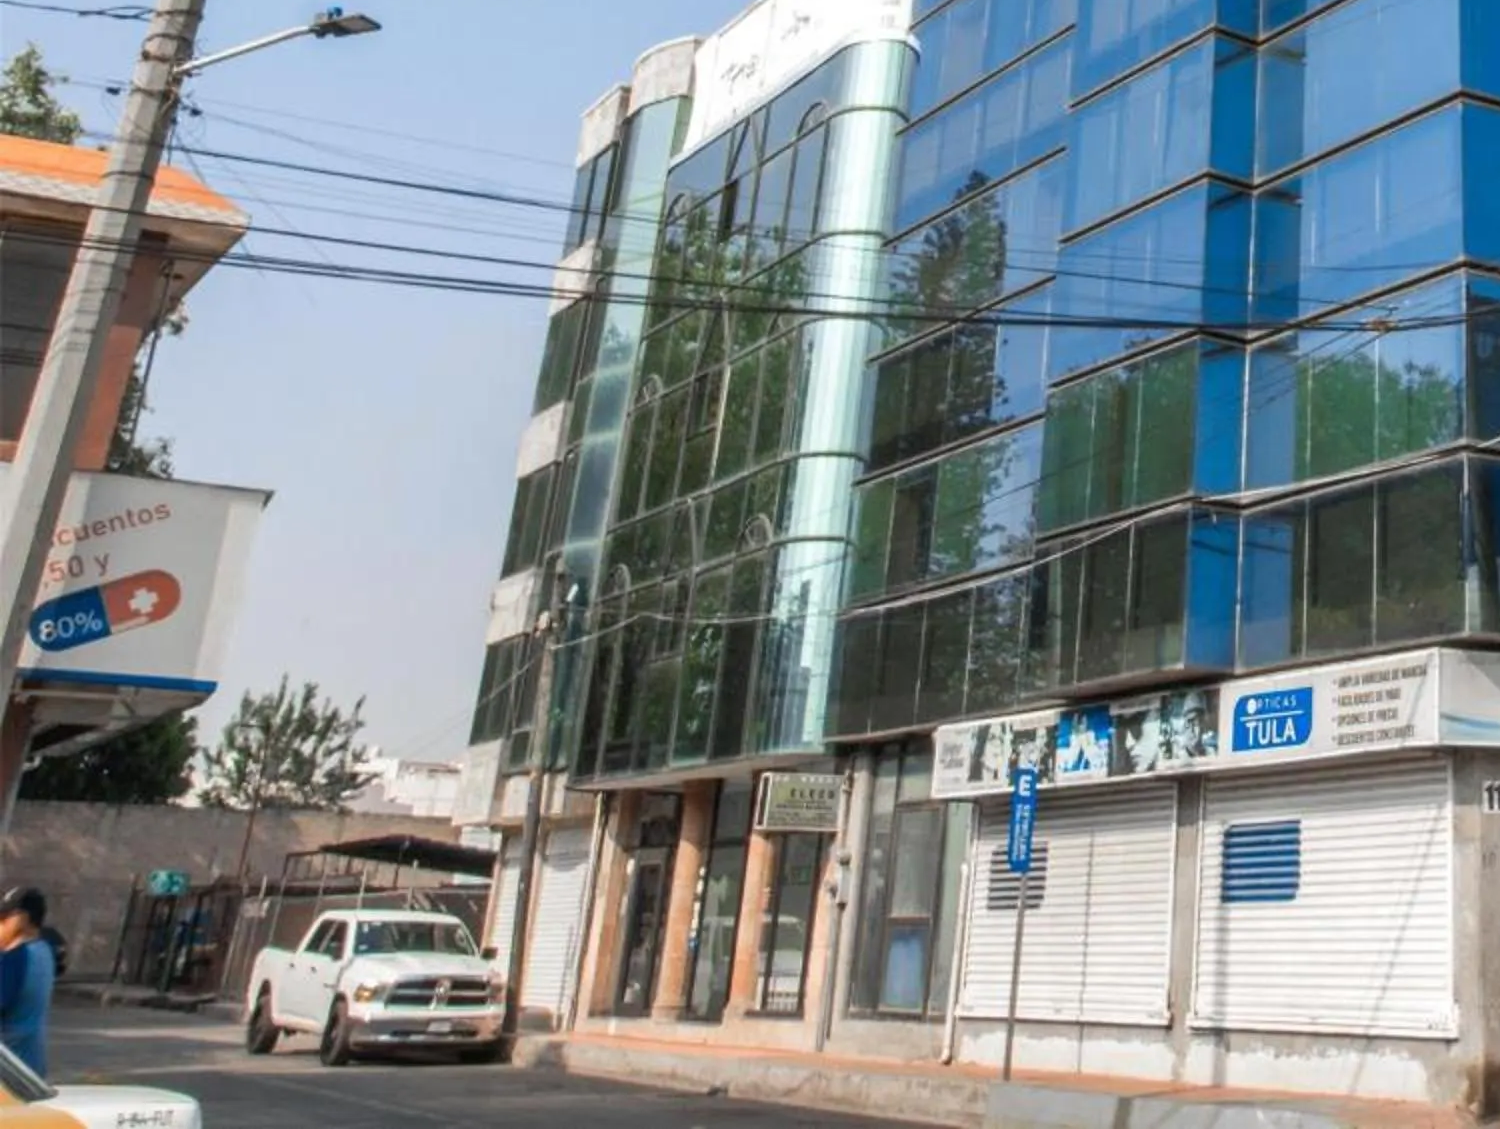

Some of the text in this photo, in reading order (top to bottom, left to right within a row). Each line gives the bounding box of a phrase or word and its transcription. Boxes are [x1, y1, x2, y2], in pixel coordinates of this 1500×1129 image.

[50, 502, 172, 547] cuentos
[94, 552, 110, 577] y
[38, 609, 103, 642] 80%
[1245, 716, 1297, 745] TULA
[1018, 774, 1033, 797] E
